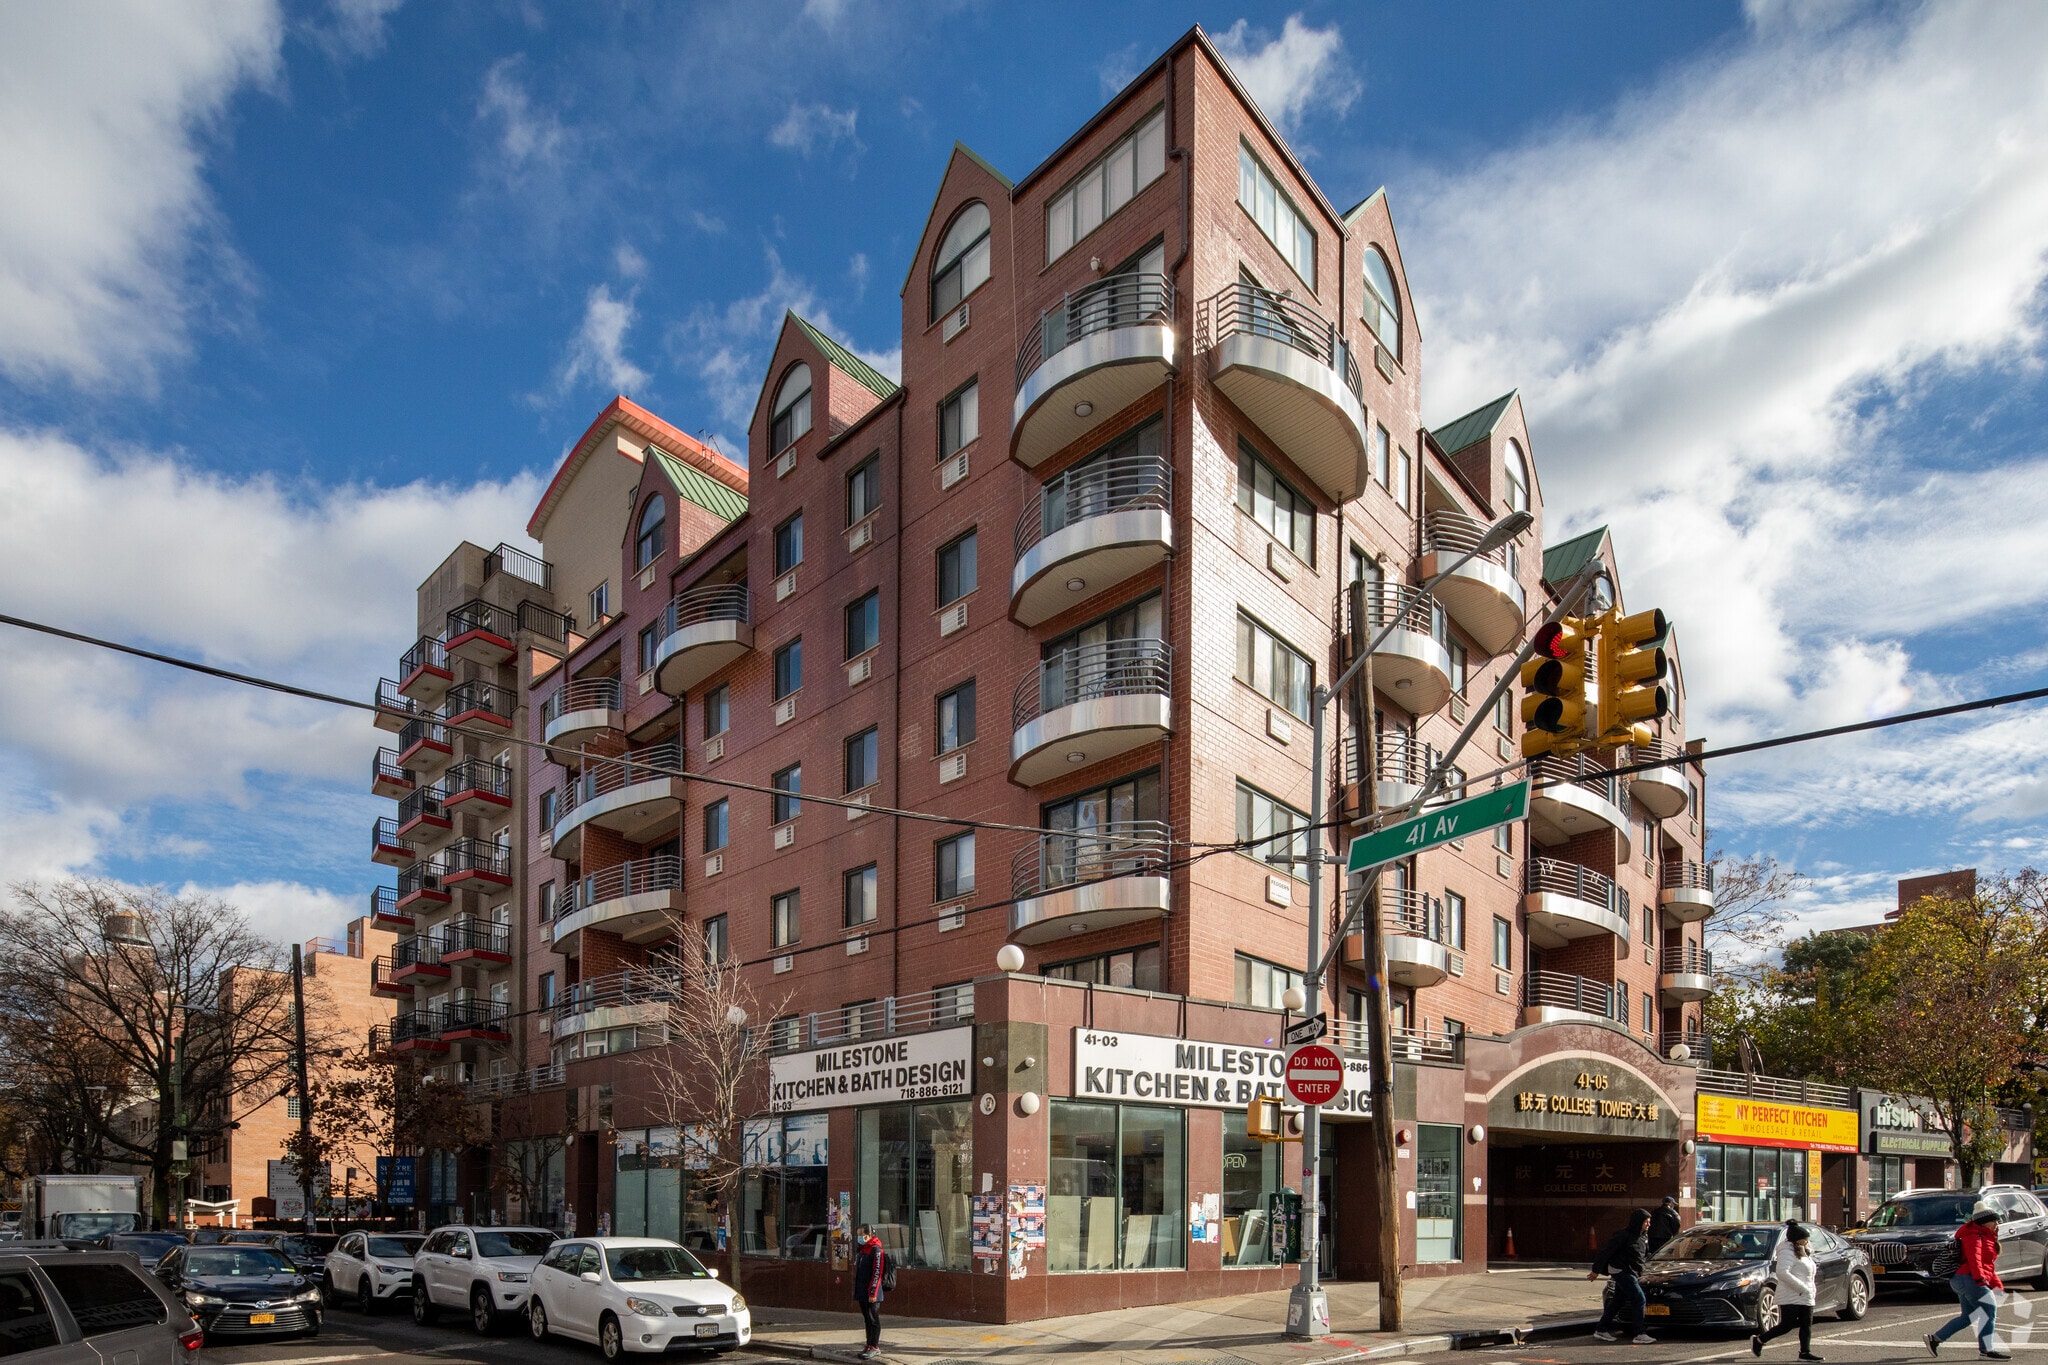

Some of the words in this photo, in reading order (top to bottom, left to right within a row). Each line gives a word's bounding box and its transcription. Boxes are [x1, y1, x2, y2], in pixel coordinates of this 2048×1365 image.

[1405, 824, 1426, 846] 41
[1433, 815, 1460, 839] Av
[1290, 1029, 1303, 1041] ONE
[1308, 1021, 1321, 1034] WAY
[1084, 1034, 1118, 1047] 41-03
[815, 1041, 908, 1073] MILESTONE
[1175, 1044, 1286, 1078] MILESTO
[1294, 1056, 1308, 1067] DO
[1314, 1057, 1334, 1067] NOT
[773, 1075, 835, 1101] KITCHEN
[838, 1075, 849, 1094] &
[851, 1068, 892, 1093] BATH
[896, 1059, 966, 1088] DESIGN
[1085, 1066, 1209, 1101] KITCHEN
[1214, 1078, 1230, 1103] &
[1297, 1083, 1330, 1094] ENTER
[1577, 1072, 1608, 1090] 41-05
[900, 1083, 963, 1100] 718-886-6121
[1520, 1091, 1548, 1111] 狀元
[1551, 1094, 1596, 1115] COLLEGE
[1599, 1099, 1633, 1118] TOWER
[1635, 1103, 1659, 1121] 大樓
[1736, 1104, 1749, 1120] NY
[1752, 1106, 1790, 1124] PERFECT
[1793, 1111, 1828, 1128] KITCHEN
[1743, 1123, 1788, 1136] WHOLESALE
[1791, 1128, 1796, 1137] &
[1799, 1129, 1823, 1139] RETAIL
[1880, 1136, 1920, 1150] ELECTRICAL
[1567, 1149, 1603, 1160] 41-05
[1545, 1184, 1588, 1192] COLLEGE
[1591, 1184, 1627, 1192] TOWER
